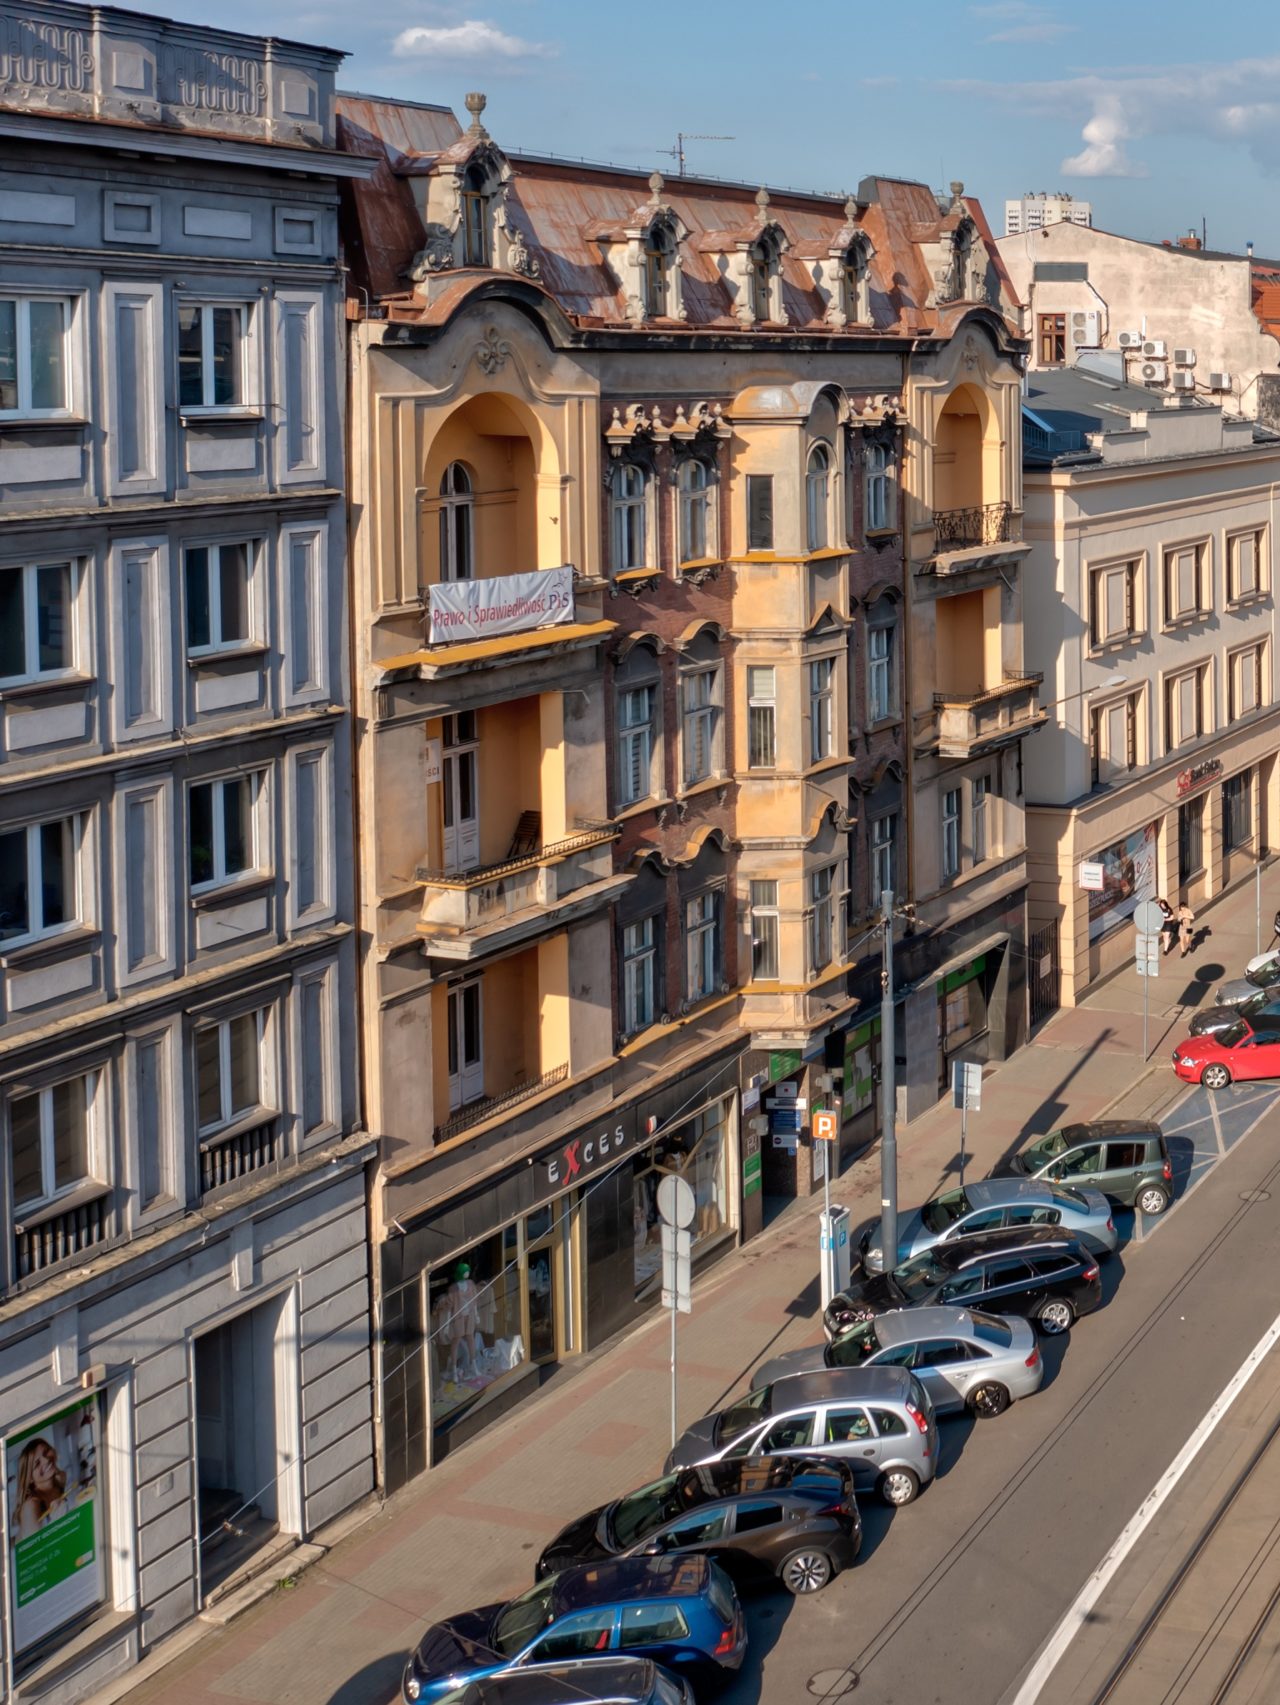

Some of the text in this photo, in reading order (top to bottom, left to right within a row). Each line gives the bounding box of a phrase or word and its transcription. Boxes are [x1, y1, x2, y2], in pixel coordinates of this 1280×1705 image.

[433, 590, 570, 627] Prawo i Sprawiedliwość PiS
[818, 1117, 832, 1135] P
[548, 1125, 624, 1185] EXCES
